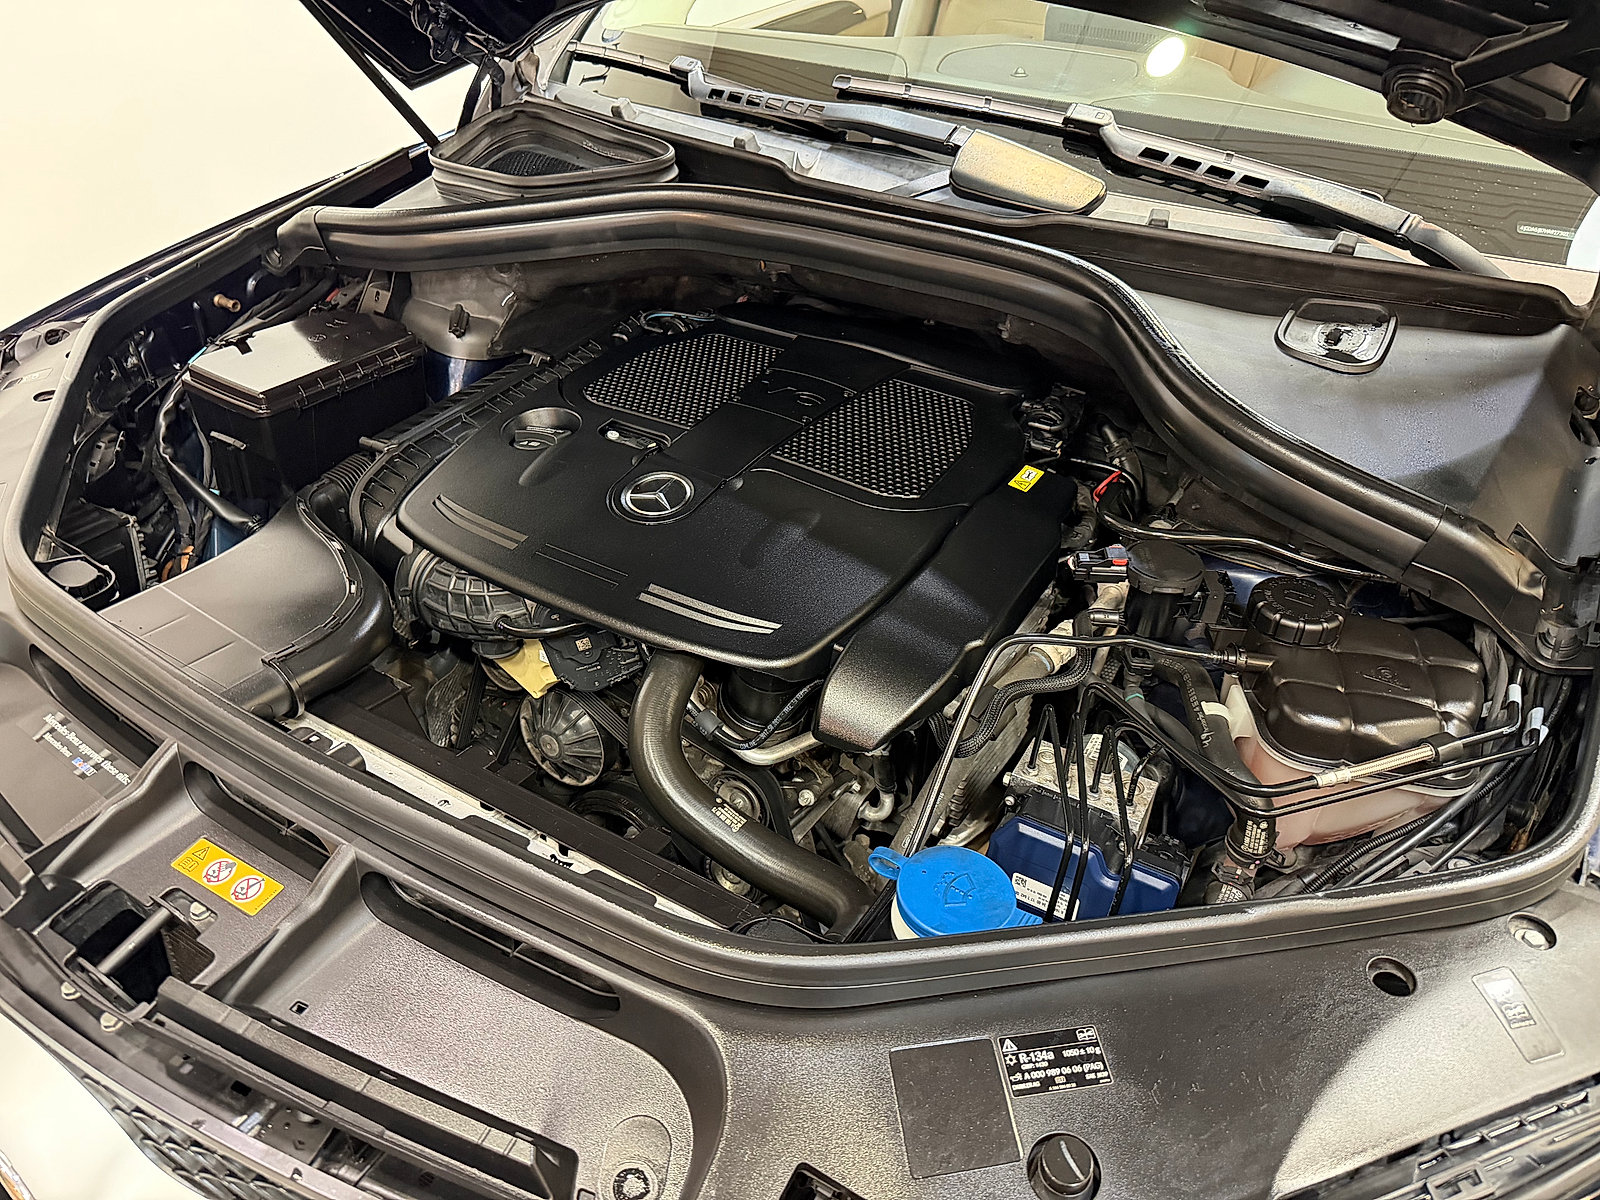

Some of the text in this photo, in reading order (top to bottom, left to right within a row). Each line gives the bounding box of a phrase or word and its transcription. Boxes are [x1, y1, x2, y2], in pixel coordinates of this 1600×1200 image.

[43, 713, 83, 746] Mercedes-Benz
[78, 743, 104, 763] approves
[100, 760, 119, 775] these
[1018, 1050, 1055, 1063] R-134a
[1062, 1048, 1079, 1057] 1050
[1086, 1046, 1095, 1054] 10
[1030, 1070, 1045, 1079] 000
[1046, 1068, 1061, 1077] 989
[1061, 1066, 1072, 1075] 06
[1072, 1064, 1082, 1073] 06
[1083, 1062, 1104, 1072] (PAG)
